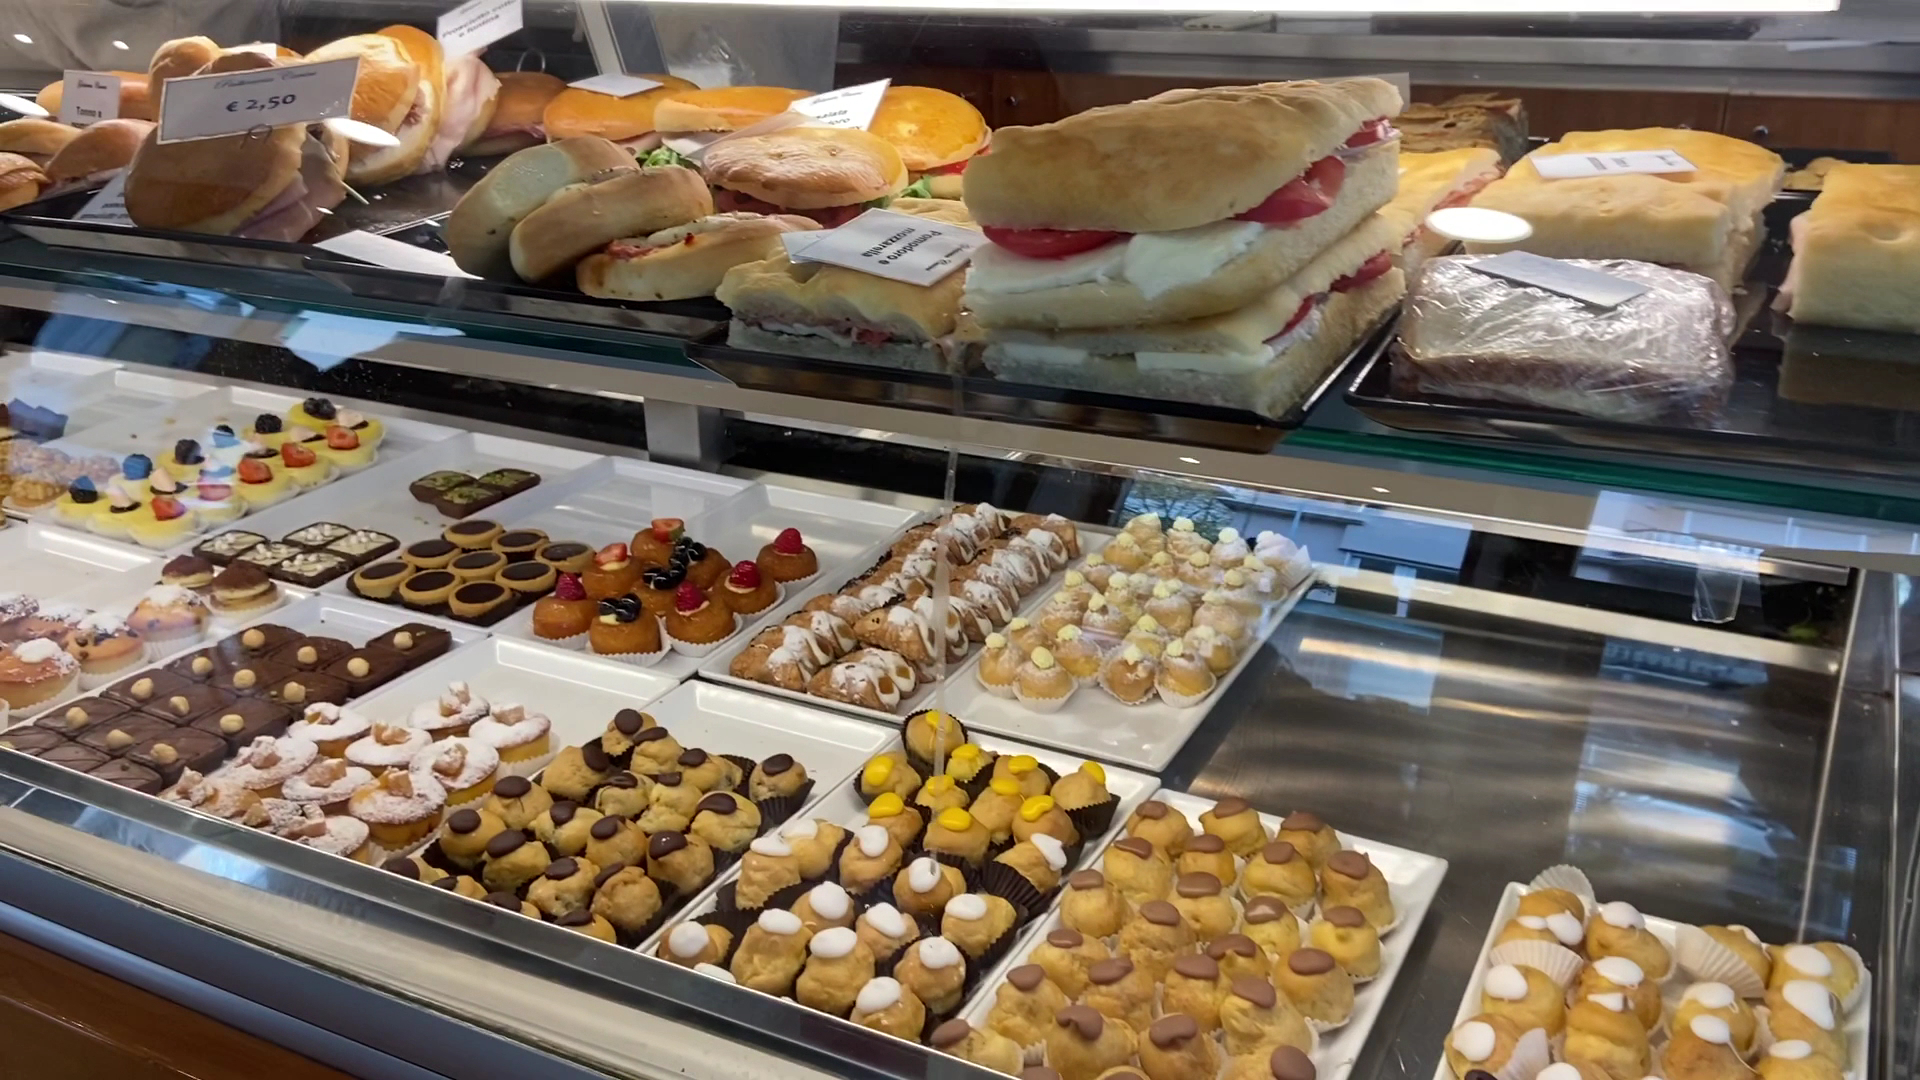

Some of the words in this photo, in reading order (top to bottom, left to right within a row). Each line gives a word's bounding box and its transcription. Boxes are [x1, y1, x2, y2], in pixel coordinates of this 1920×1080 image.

[226, 101, 239, 112] €
[246, 93, 297, 112] 2,50
[861, 227, 916, 257] mozzarella
[887, 230, 943, 261] Pomodoro
